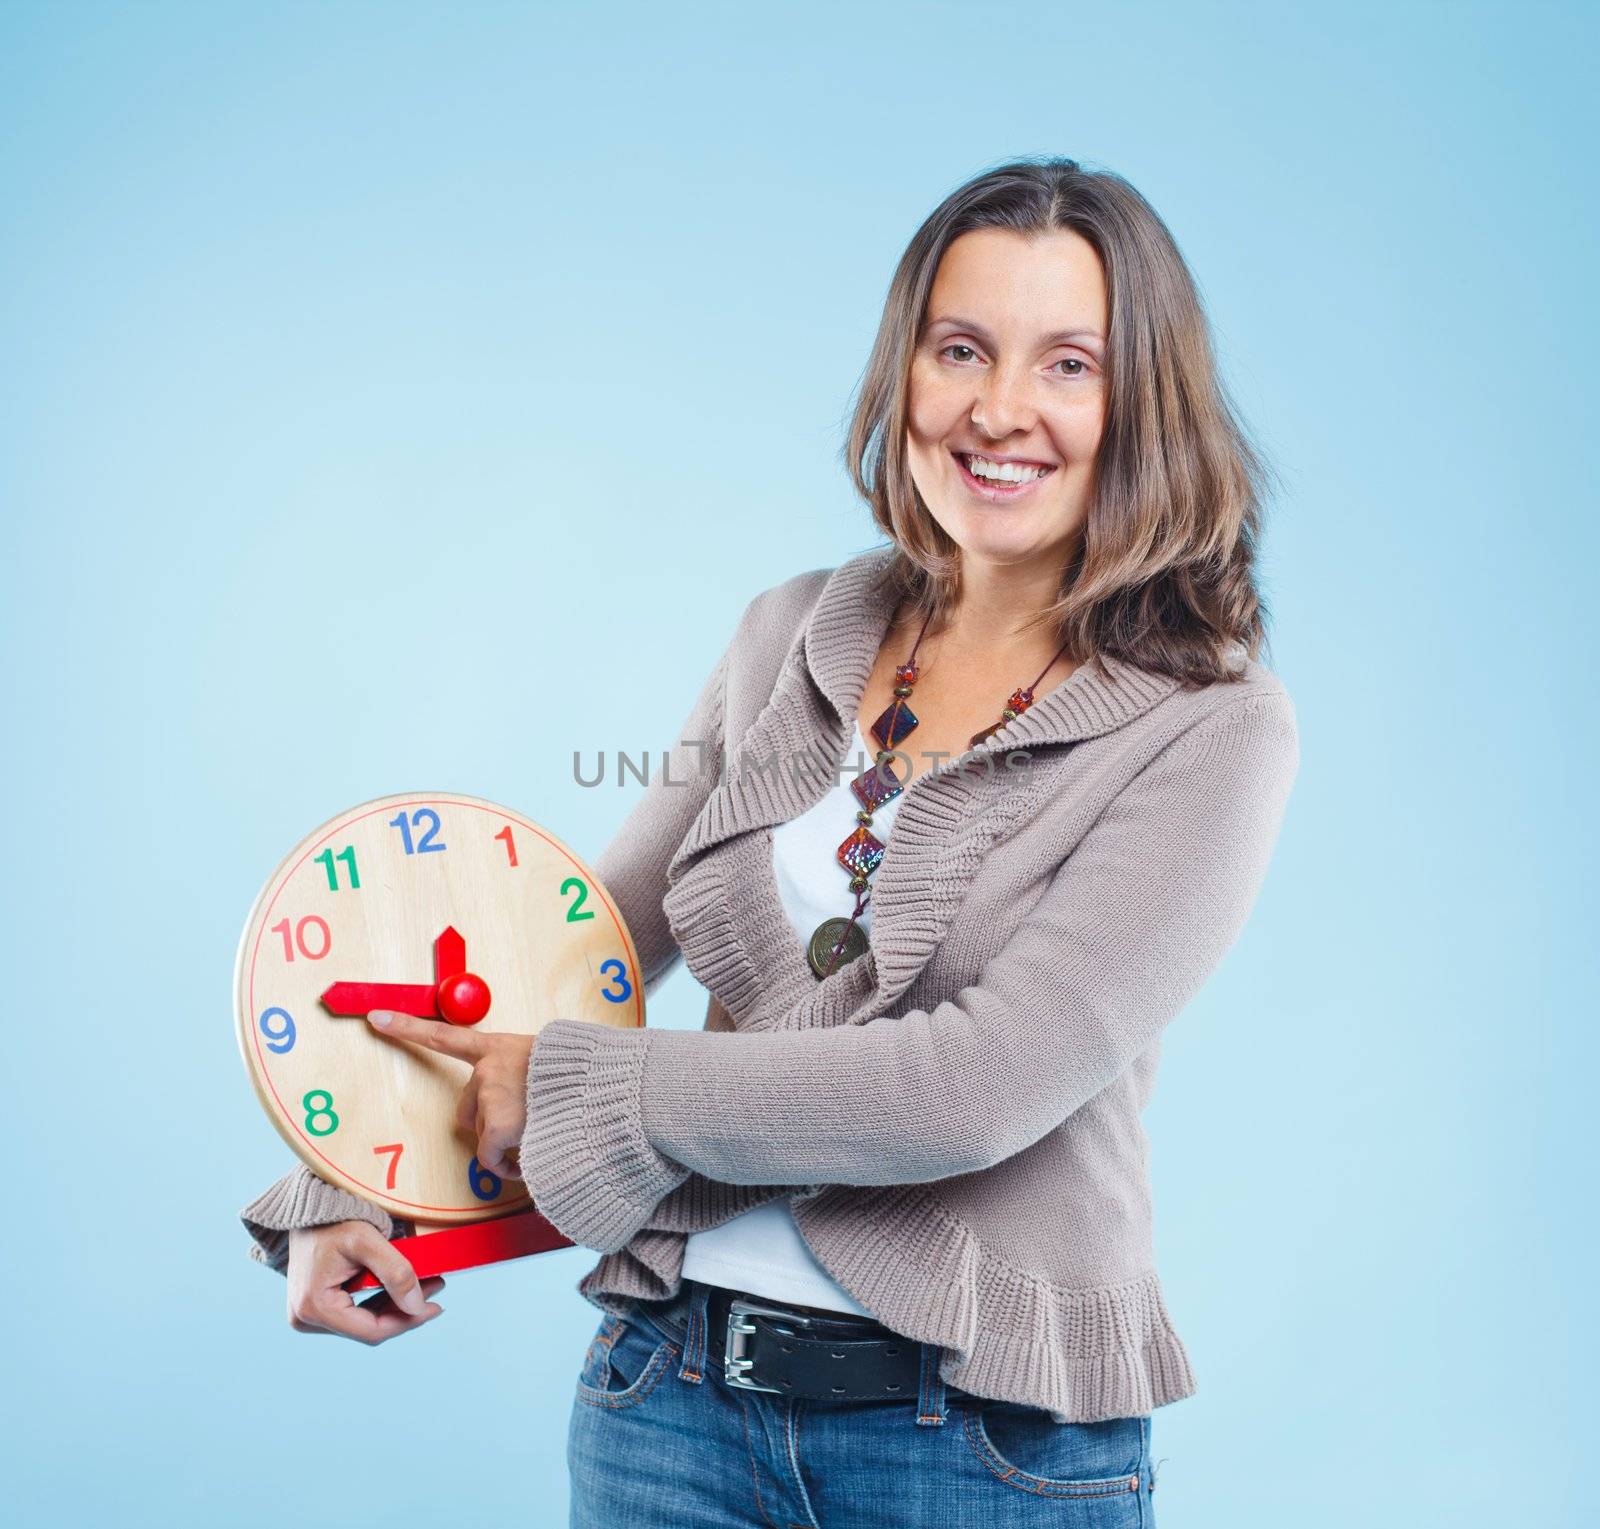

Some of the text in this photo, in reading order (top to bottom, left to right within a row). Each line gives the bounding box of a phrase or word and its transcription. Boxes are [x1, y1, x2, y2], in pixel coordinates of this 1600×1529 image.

[389, 807, 447, 856] 12
[494, 825, 519, 868] 1
[313, 845, 361, 892] 11
[559, 876, 596, 924] 2
[271, 914, 332, 963] 10
[600, 958, 632, 1004] 3
[258, 1006, 298, 1055] 9
[301, 1088, 340, 1137] 8
[373, 1143, 404, 1190] 7
[468, 1156, 502, 1201] 6
